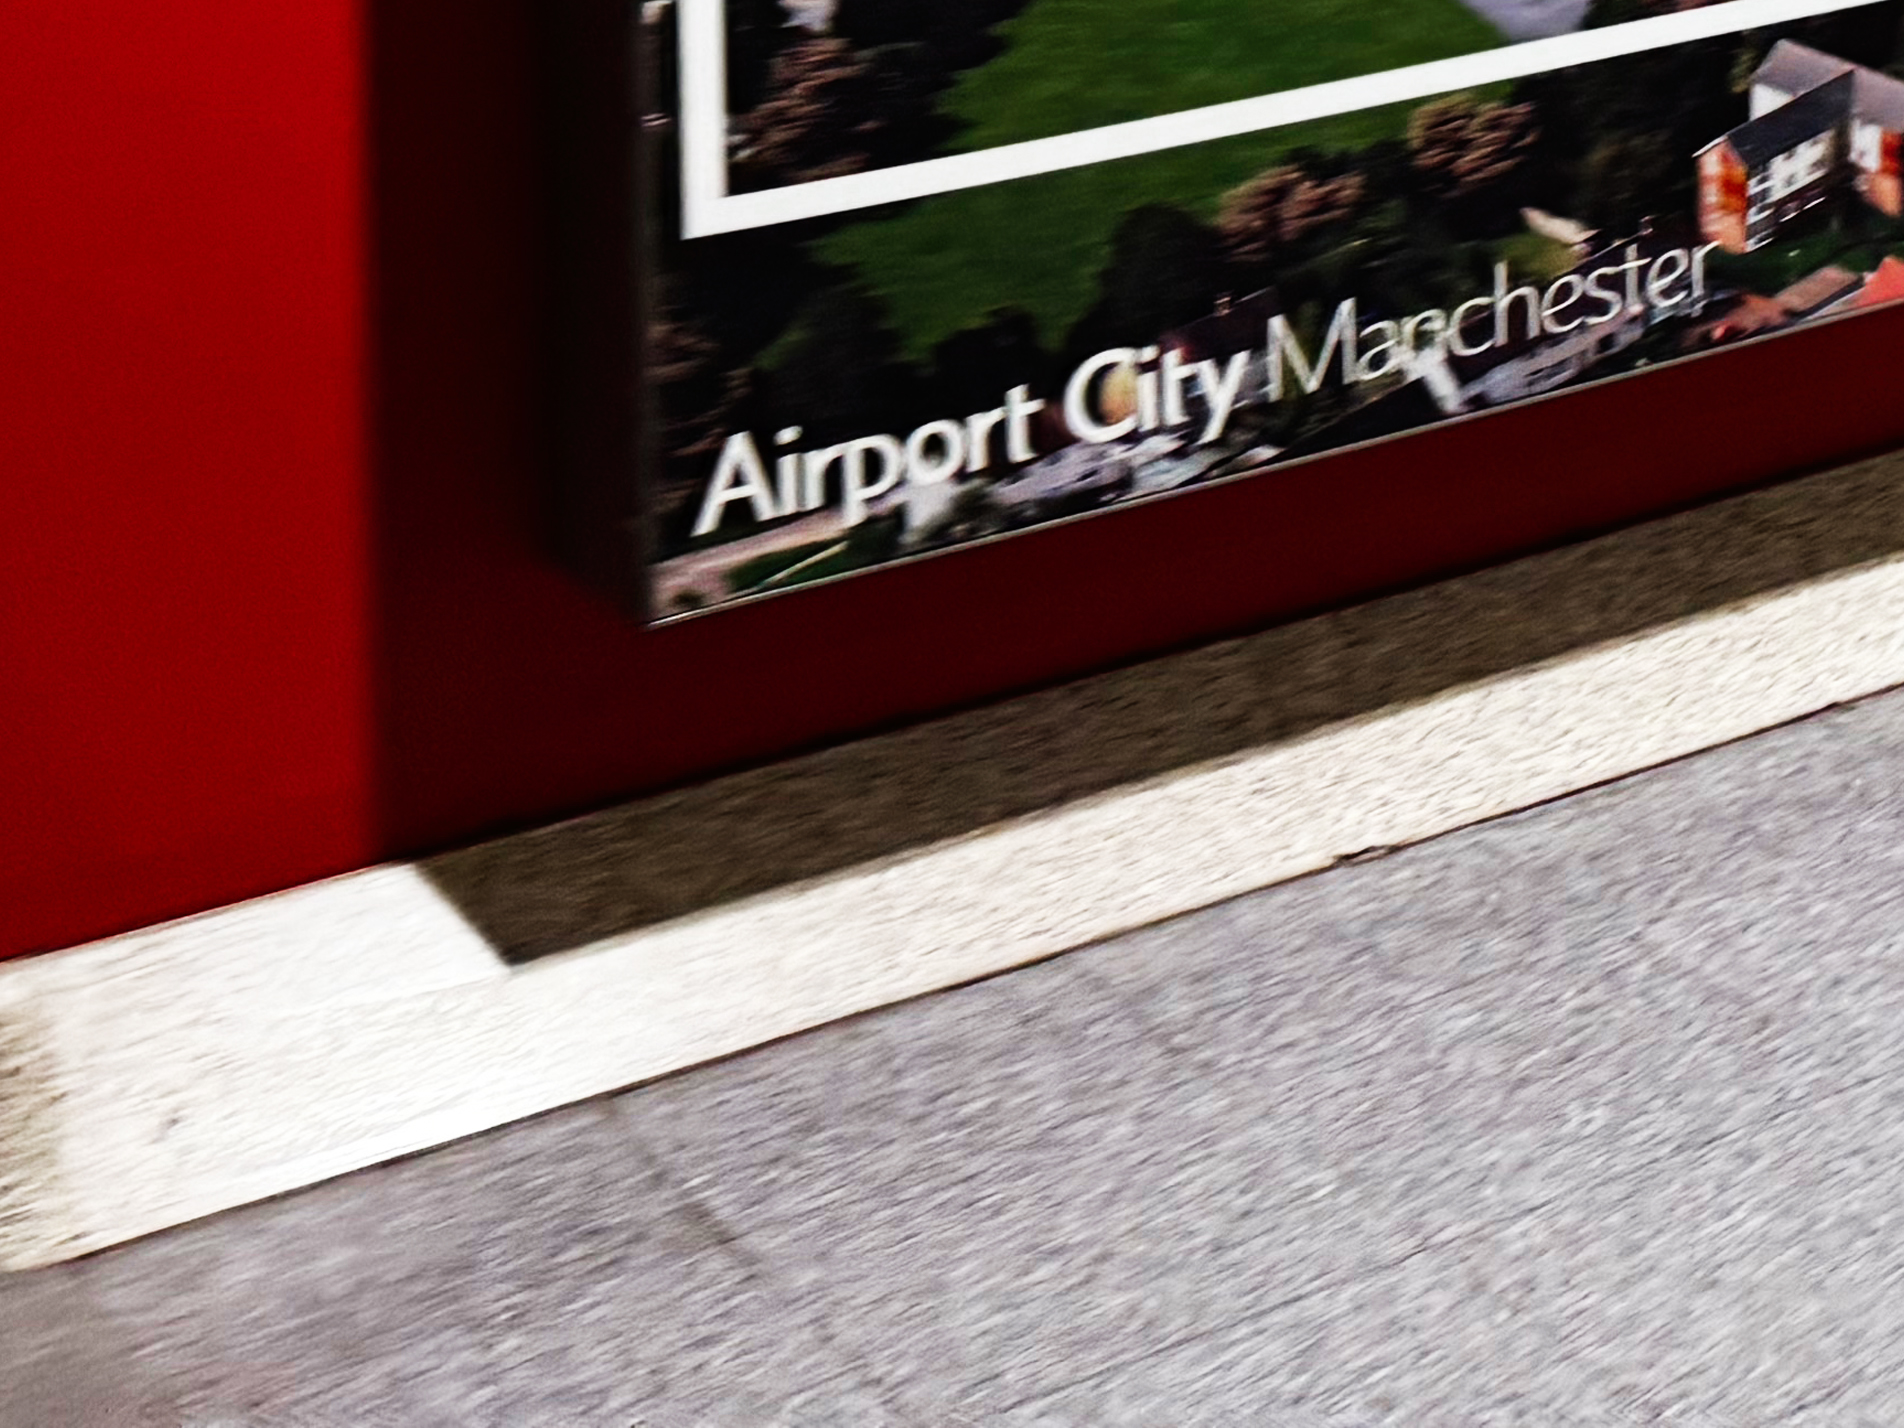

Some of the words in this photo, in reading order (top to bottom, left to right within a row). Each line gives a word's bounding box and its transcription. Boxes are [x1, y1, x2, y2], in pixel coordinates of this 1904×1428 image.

[692, 382, 1046, 537] Airport
[1063, 344, 1251, 445] City
[1265, 239, 1725, 406] Manchester
